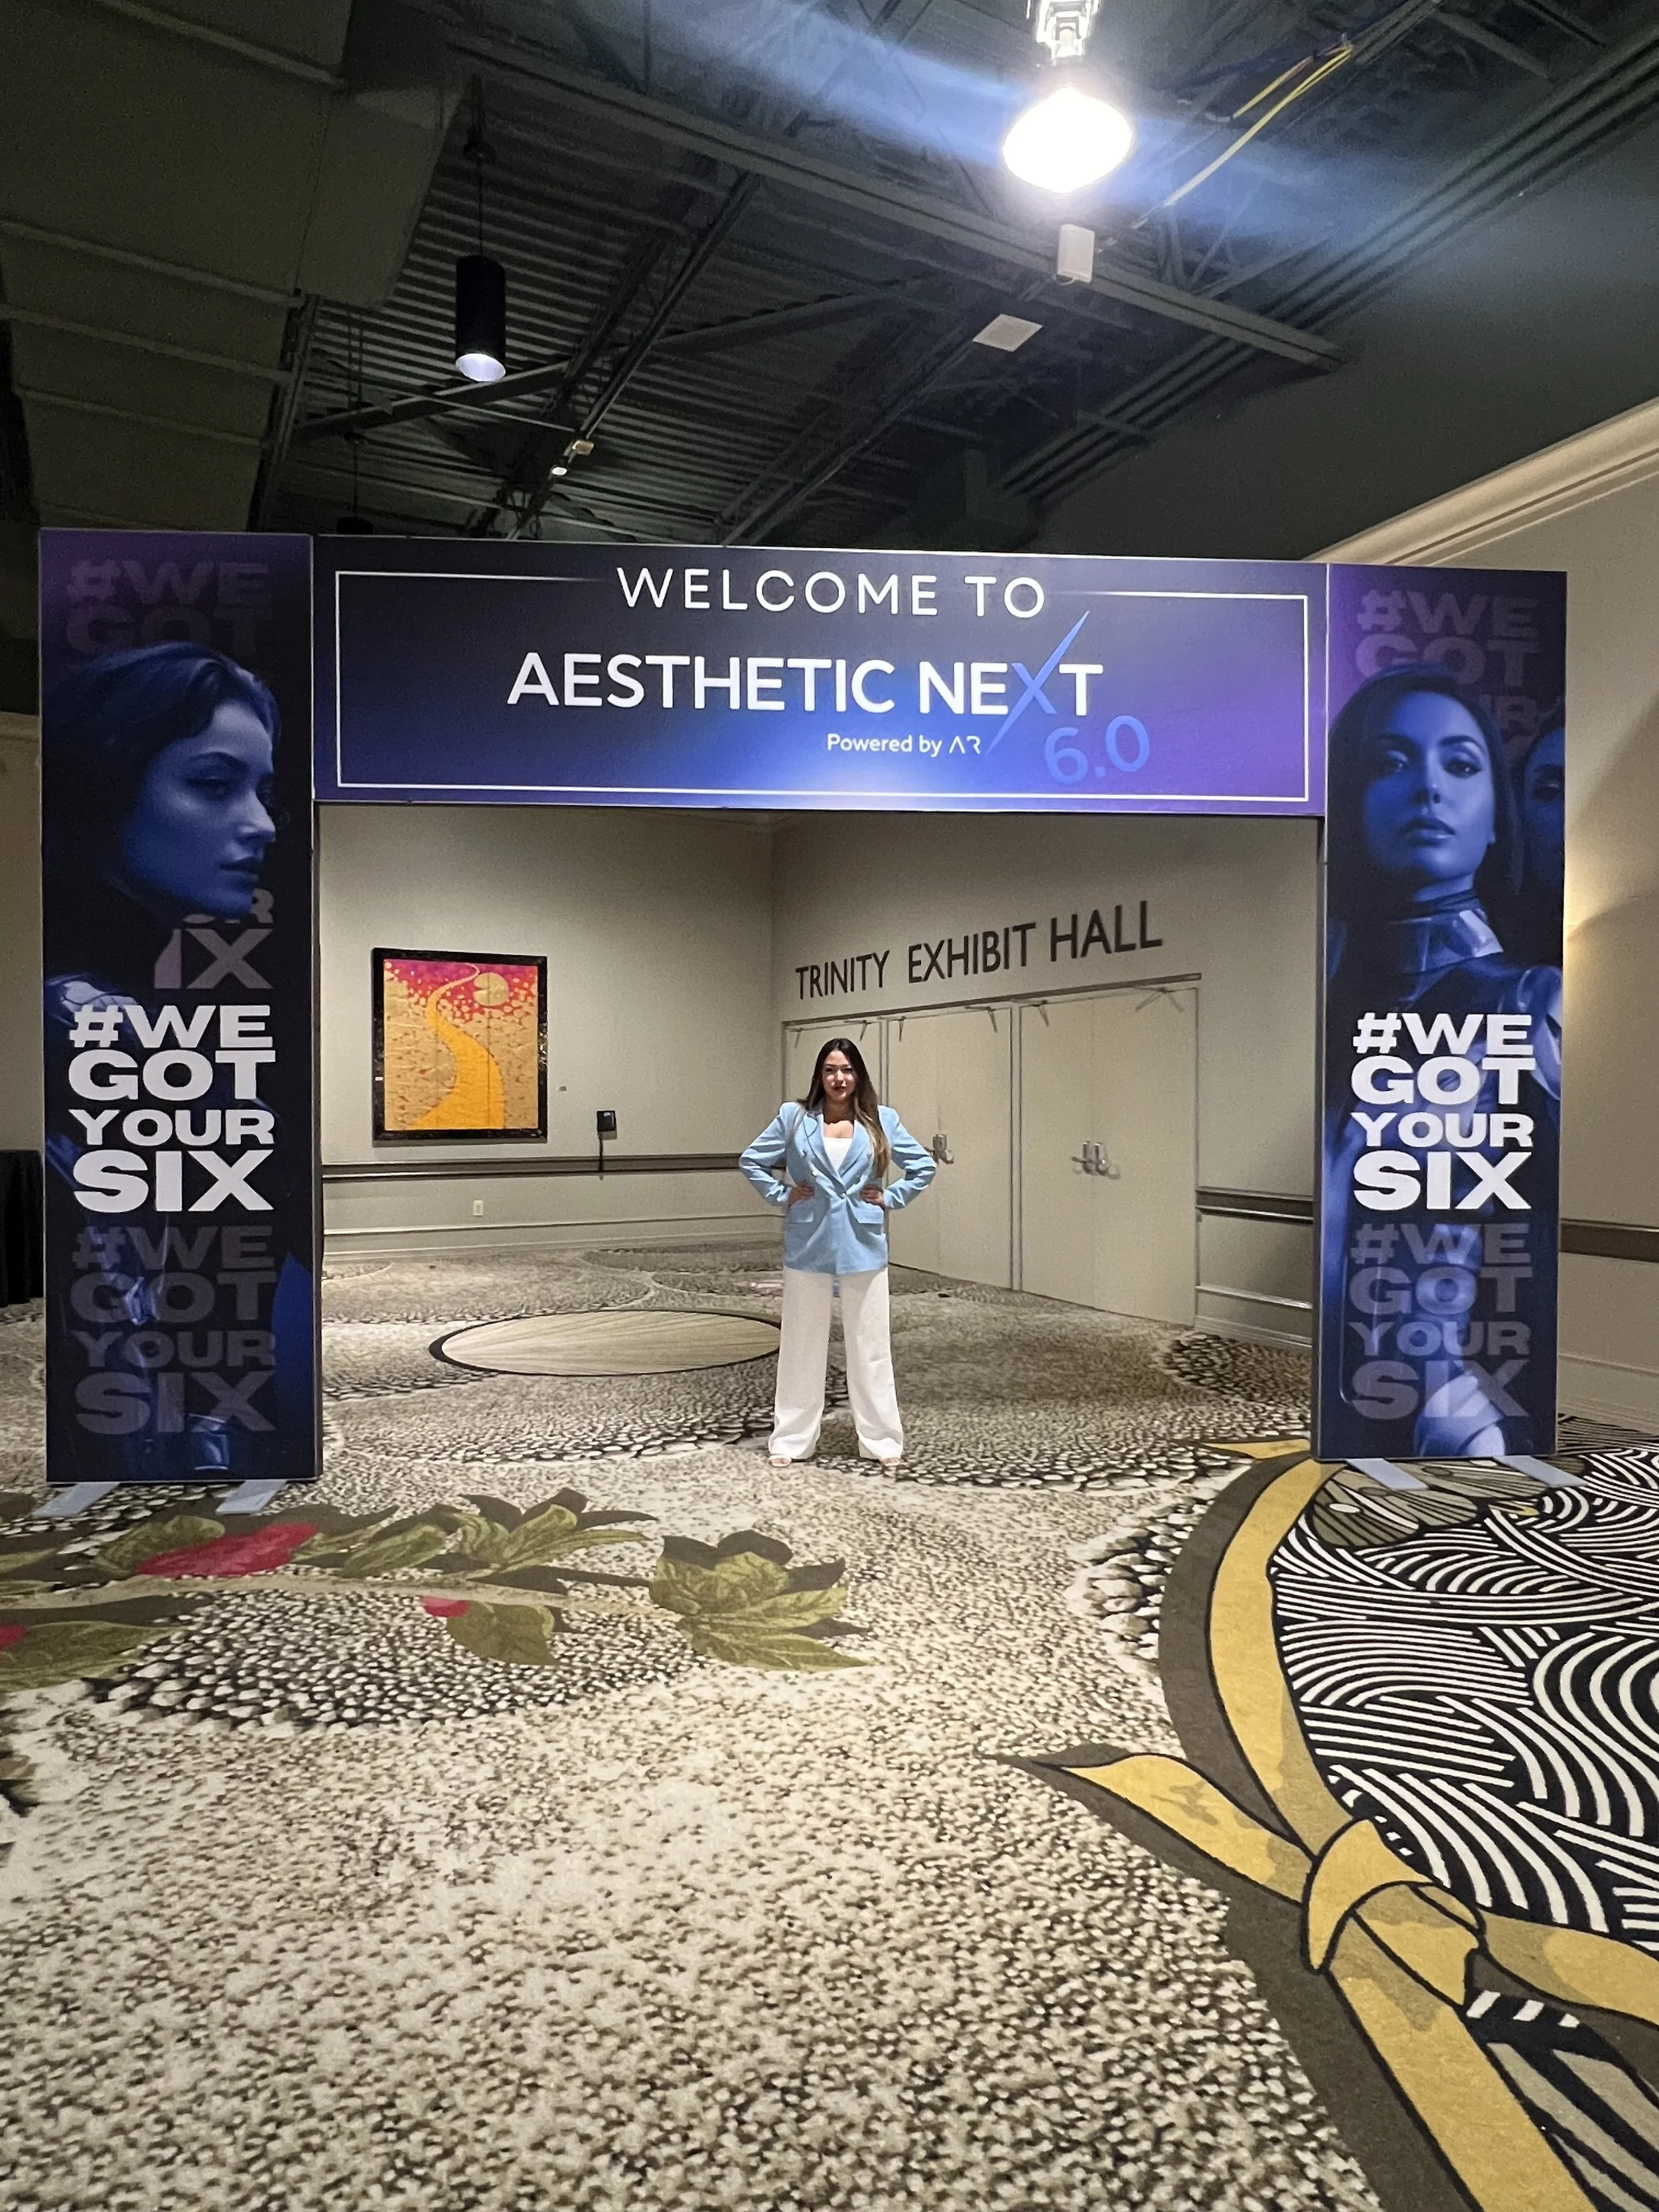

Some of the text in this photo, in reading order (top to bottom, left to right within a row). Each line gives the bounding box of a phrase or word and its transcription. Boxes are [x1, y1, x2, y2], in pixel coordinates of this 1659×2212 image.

[68, 559, 270, 604] #WE
[617, 567, 1045, 619] WELCOME TO
[1357, 589, 1540, 638] #WE
[507, 652, 895, 715] AESTHETIC
[827, 733, 912, 753] Powered
[920, 735, 943, 757] by
[1045, 715, 1150, 784] 6.0
[154, 928, 275, 990] IX
[796, 900, 1163, 999] TRINITY EXHIBIT HALL
[69, 1005, 273, 1048] #WE
[1353, 1012, 1533, 1055] #WE
[68, 1049, 275, 1101] GOT
[1351, 1056, 1536, 1106] GOT
[69, 1109, 274, 1147] YOUR
[1351, 1112, 1534, 1147] YOUR
[74, 1149, 274, 1213] SIX
[1353, 1151, 1532, 1211] SIX
[72, 1226, 275, 1270] #WE
[1350, 1224, 1530, 1264] #WE
[70, 1272, 277, 1323] GOT
[1348, 1266, 1532, 1315] GOT
[76, 1331, 275, 1368] YOUR
[1348, 1321, 1531, 1357] YOUR
[76, 1371, 275, 1434] SIX
[1353, 1360, 1529, 1420] SIX
